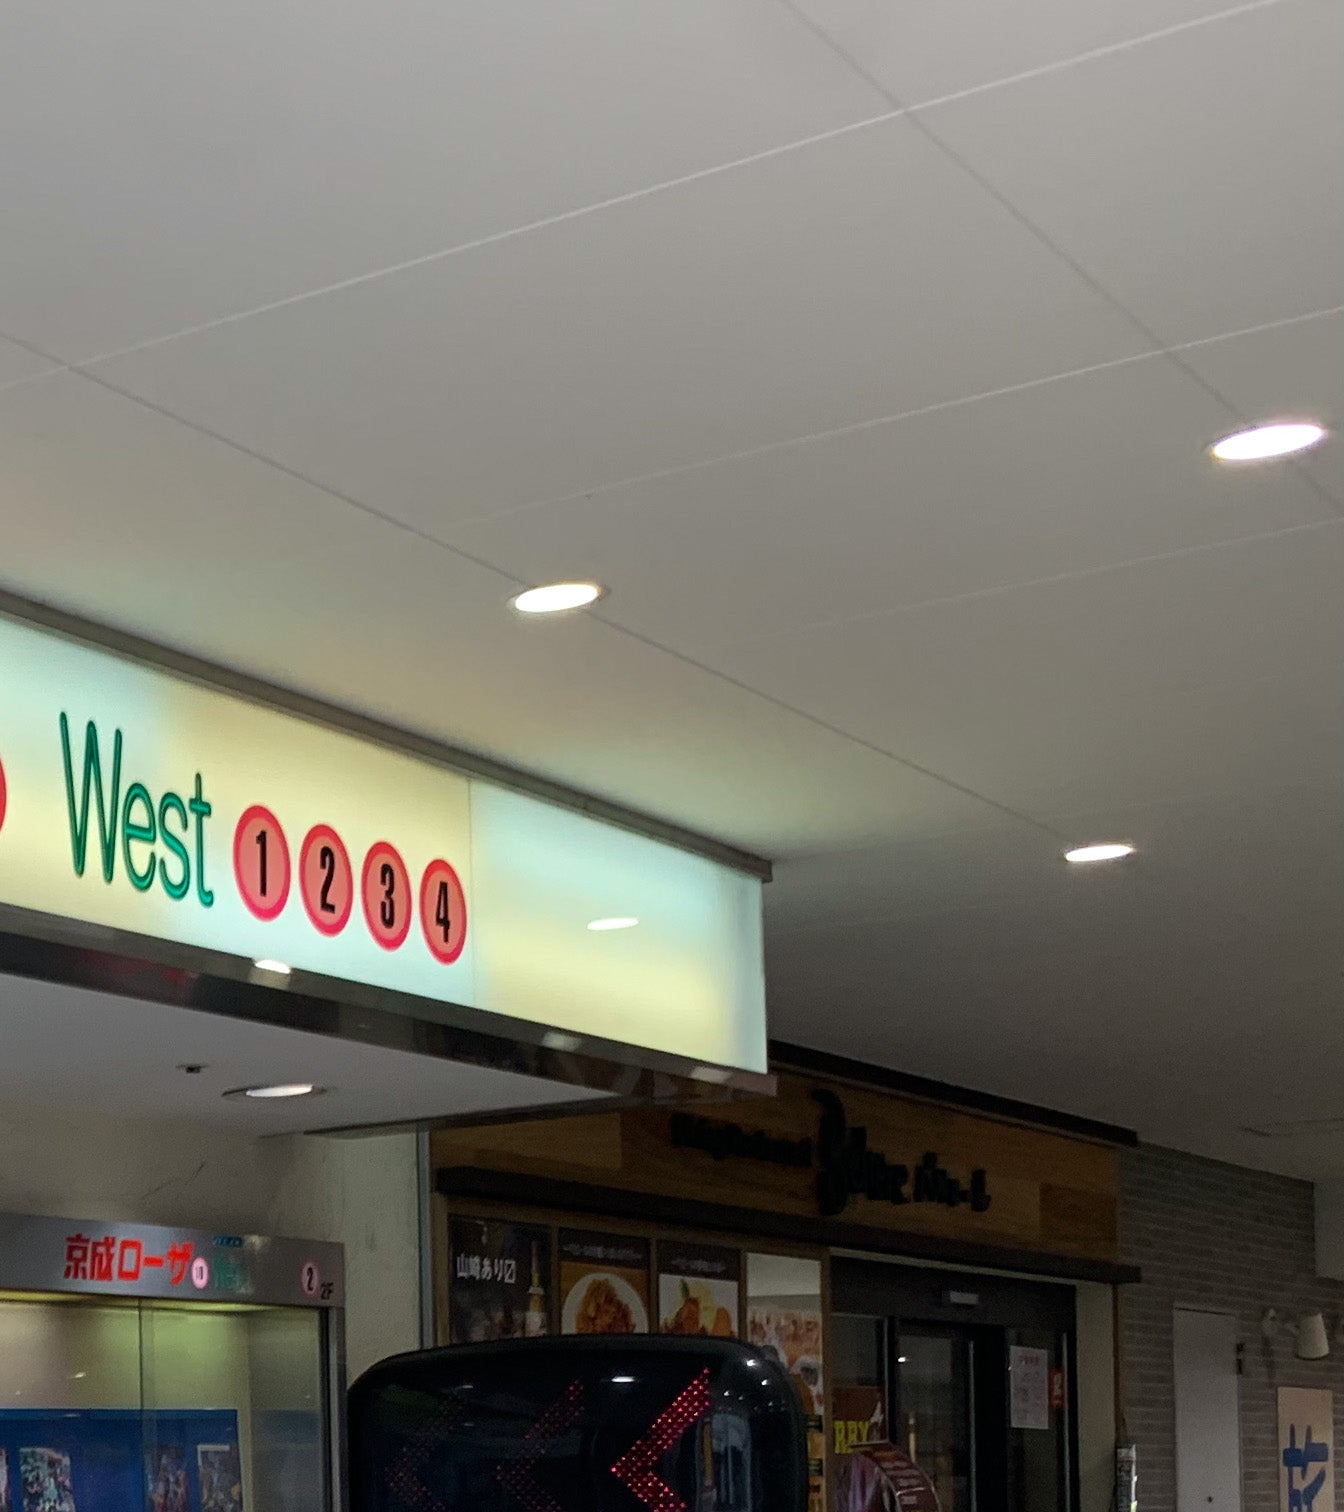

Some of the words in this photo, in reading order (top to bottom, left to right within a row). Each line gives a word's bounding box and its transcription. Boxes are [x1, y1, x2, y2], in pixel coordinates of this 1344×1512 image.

[59, 711, 214, 908] West
[64, 1233, 194, 1287] 京成ローザ
